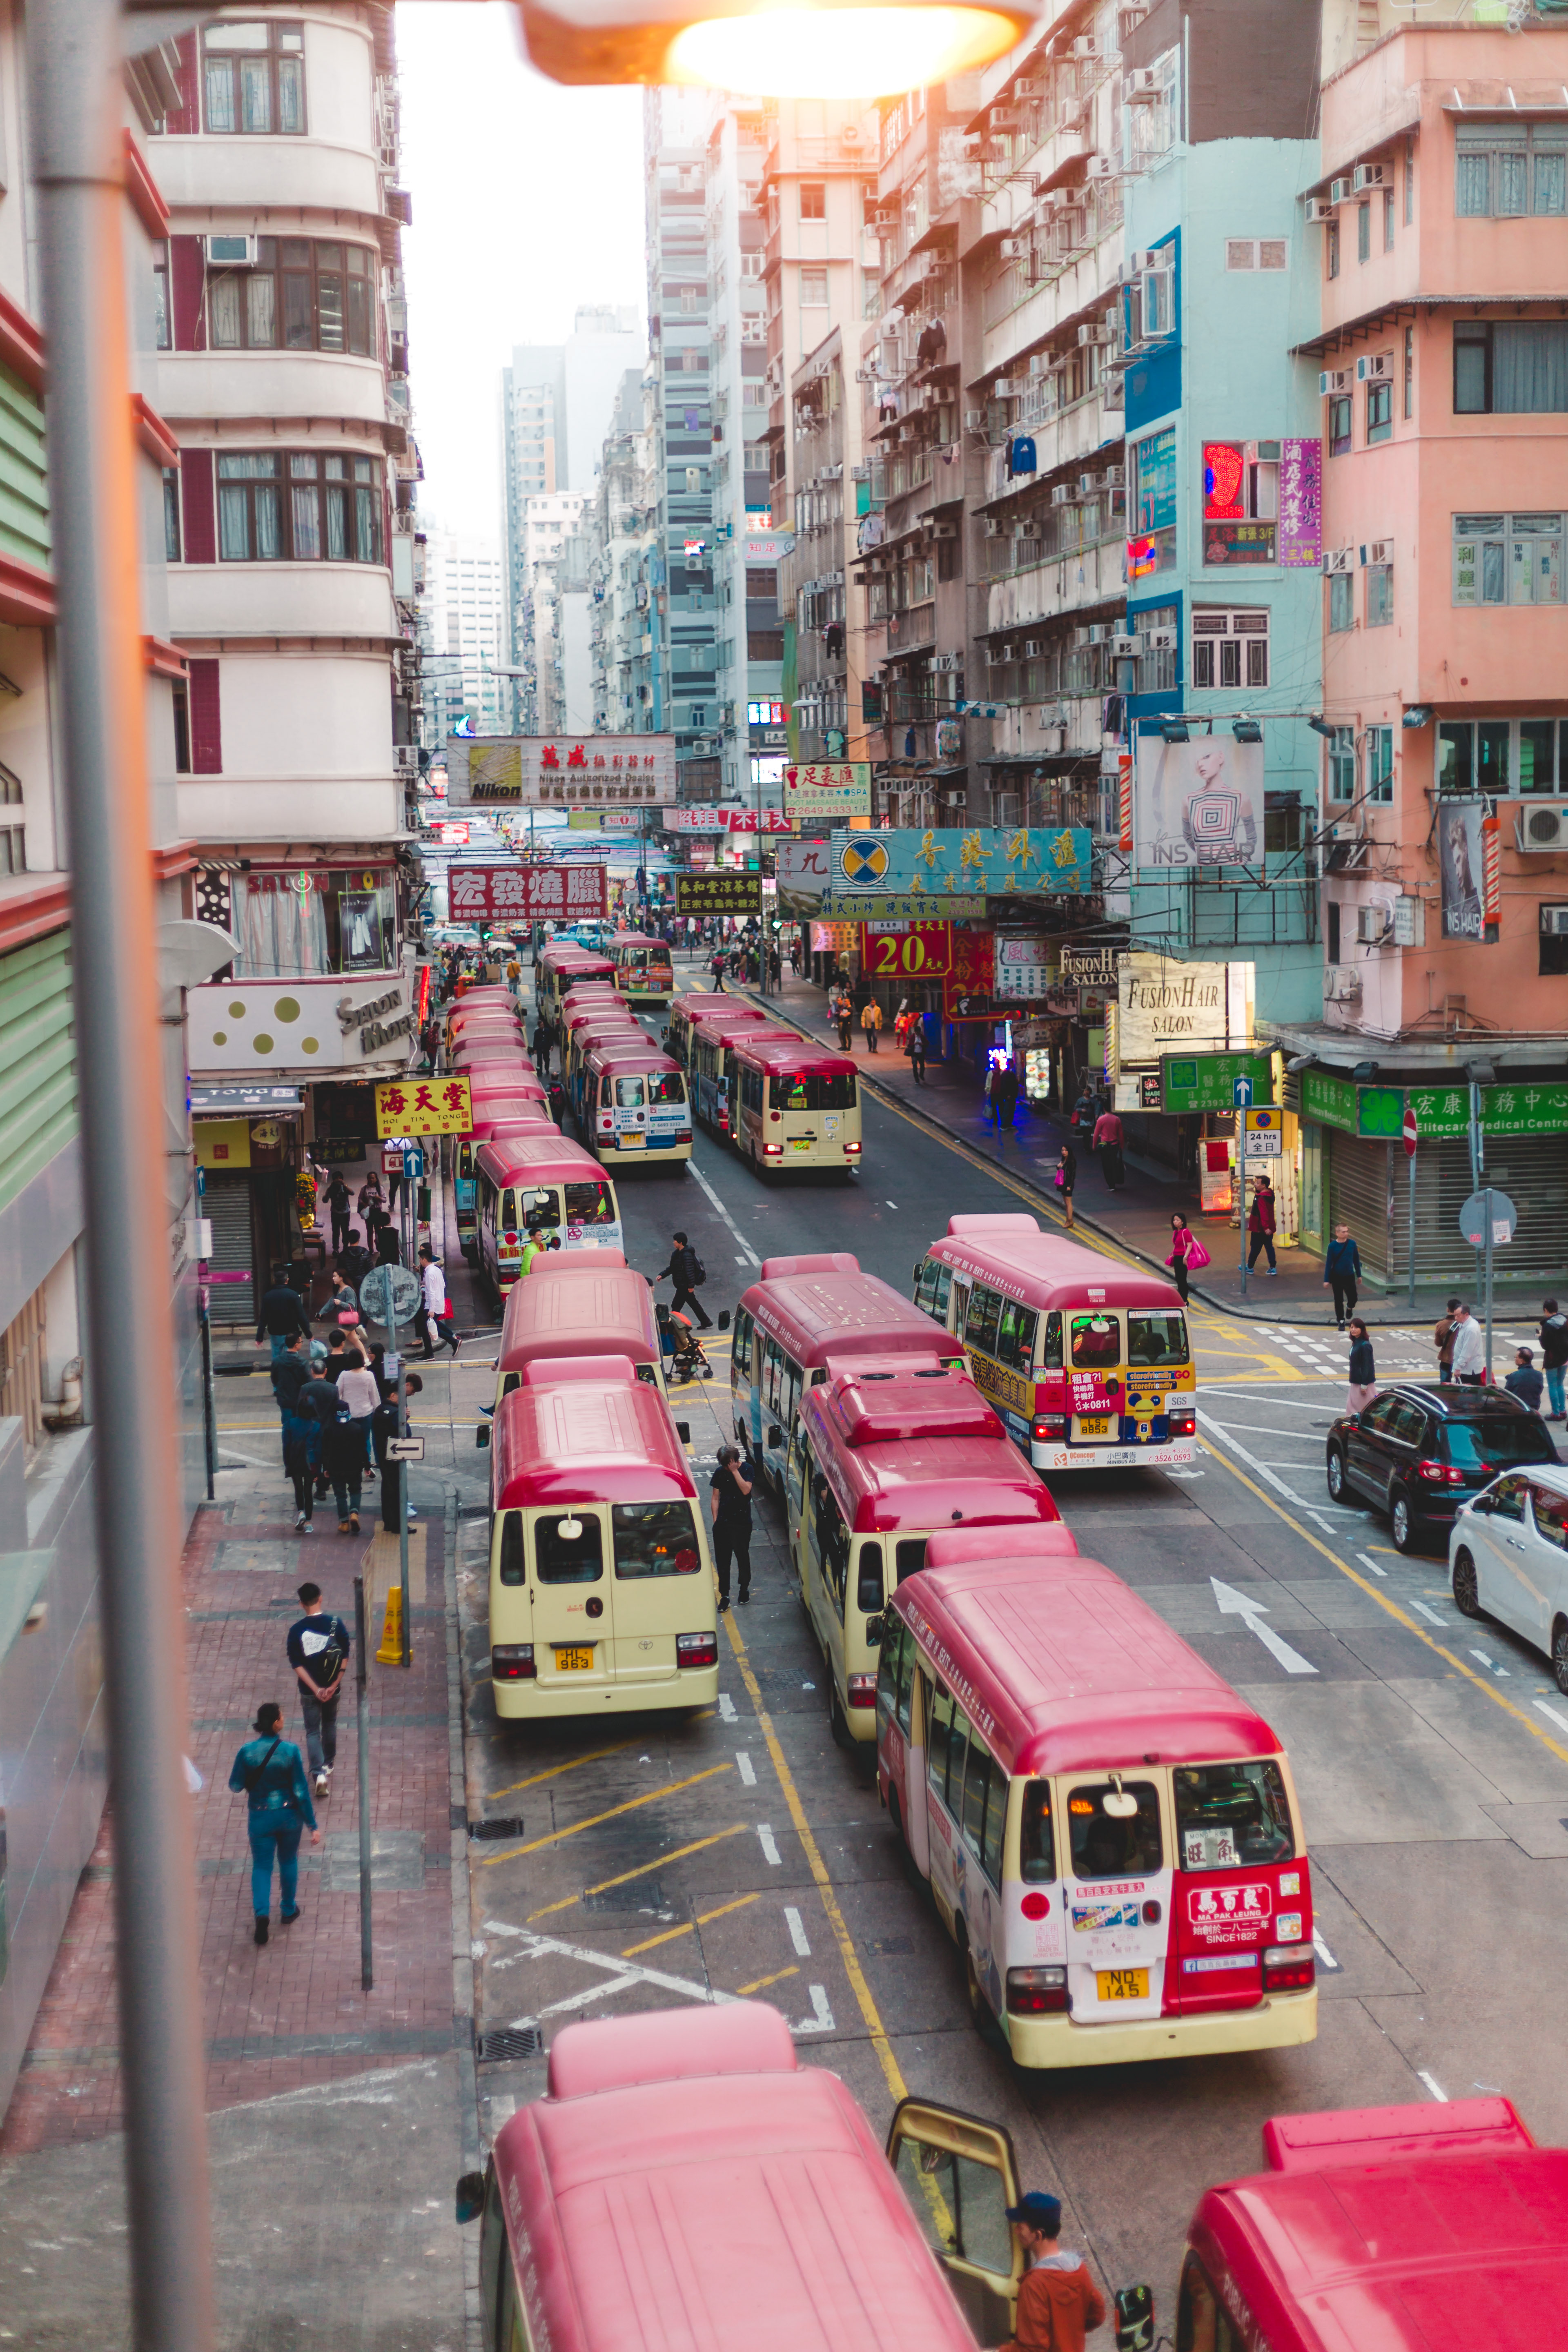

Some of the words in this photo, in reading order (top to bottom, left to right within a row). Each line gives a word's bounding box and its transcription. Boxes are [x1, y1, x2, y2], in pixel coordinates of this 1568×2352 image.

[1259, 527, 1274, 539] 3/F
[749, 543, 777, 552] 知足
[539, 774, 565, 783] Nikon
[626, 773, 655, 782] Dealer
[472, 783, 521, 797] Nikon
[798, 806, 823, 815] 2649
[679, 811, 721, 825] 招租
[735, 812, 790, 829] 不夜天
[1153, 844, 1188, 864] INS
[1197, 842, 1255, 863] HAIR
[784, 846, 794, 879] 老字號
[801, 852, 828, 875] 九
[248, 873, 329, 893] SALON
[452, 869, 602, 905] 宏發燒臘
[1448, 912, 1459, 931] INS
[1461, 913, 1480, 933] HAIR
[875, 936, 924, 972] 20
[1007, 941, 1053, 961] 風味
[1072, 973, 1118, 986] SALON
[338, 989, 402, 1034] SALON
[1152, 1016, 1194, 1033] SALON
[1216, 1058, 1250, 1072] 宏康
[1203, 1074, 1265, 1087] 醫務心
[380, 1083, 468, 1115] 海天堂
[1479, 1120, 1523, 1129] edical
[1253, 1143, 1274, 1152] 全日
[942, 1250, 953, 1261] PUBLIC
[952, 1256, 962, 1266] LIGHT
[968, 1264, 973, 1272] 16
[973, 1265, 984, 1277] SEATS
[1175, 1370, 1189, 1379] GO
[1074, 1392, 1094, 1401] 手機打
[1082, 1425, 1107, 1434] 8853
[907, 1601, 919, 1624] PUBLIC
[916, 1616, 927, 1636] LIGHT
[926, 1631, 934, 1647] BUS
[933, 1642, 940, 1655] 16
[938, 1648, 951, 1669] SEATS
[566, 1650, 583, 1659] HL
[561, 1659, 588, 1669] 963
[1188, 1839, 1232, 1863] 旺角
[1198, 1888, 1261, 1914] 馬百良
[1233, 1909, 1261, 1919] LEUNG
[1037, 1925, 1057, 1936] 香港
[1193, 1920, 1269, 1936] 始創於一八二二年
[1111, 1970, 1135, 1984] ND
[1106, 1983, 1139, 1999] 145
[1223, 2273, 1249, 2336] PUBLIC
